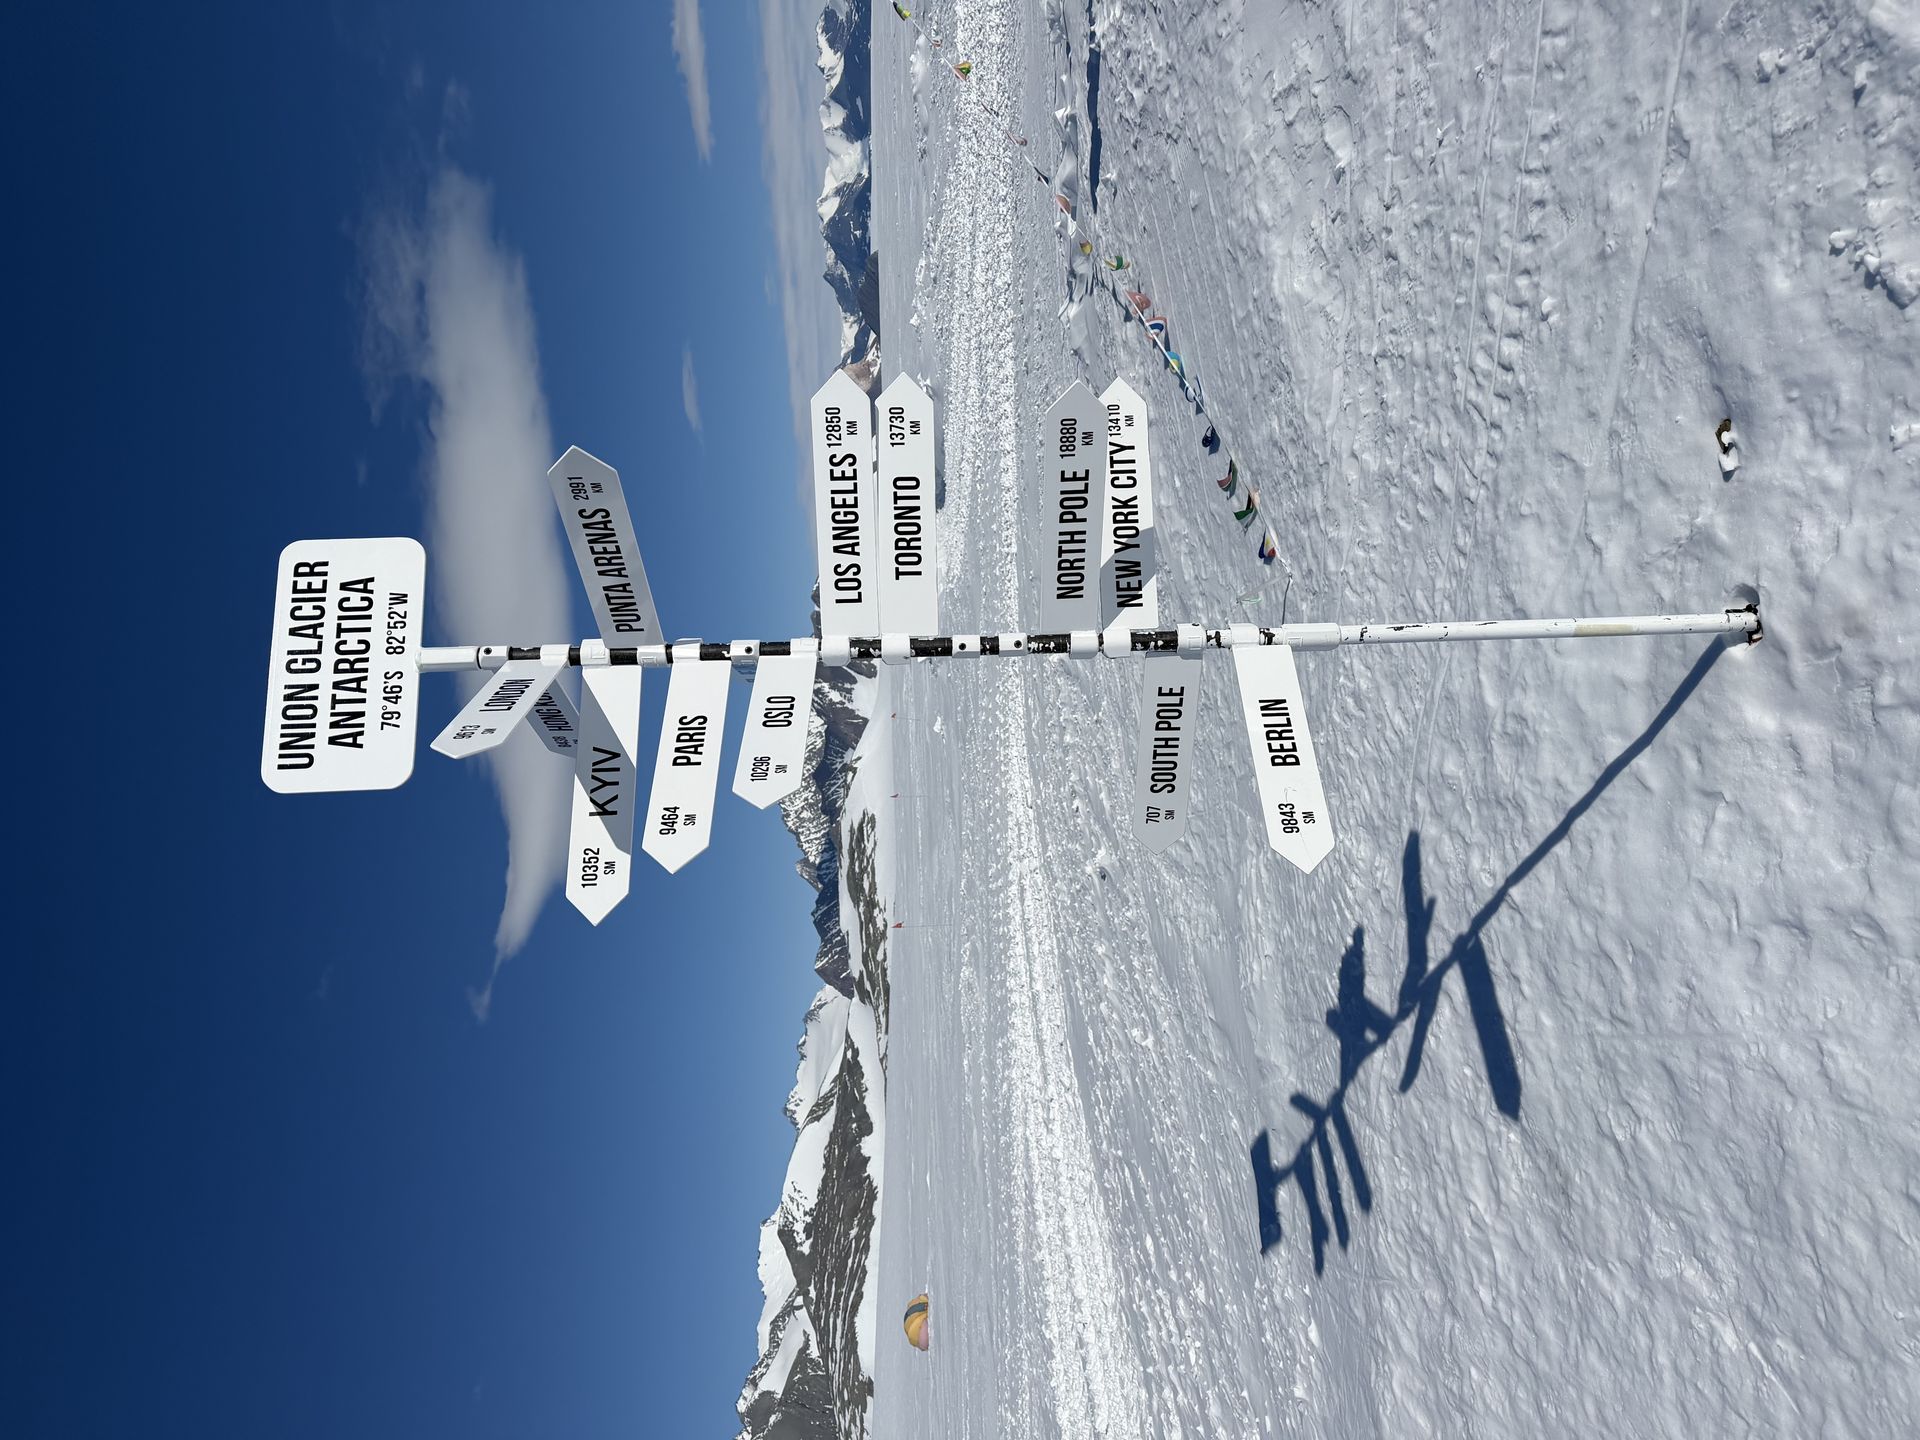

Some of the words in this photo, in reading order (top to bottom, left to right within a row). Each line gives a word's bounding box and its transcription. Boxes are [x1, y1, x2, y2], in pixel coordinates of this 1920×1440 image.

[824, 406, 843, 449] 12850
[846, 420, 858, 436] KM
[888, 406, 906, 448] 13730
[909, 420, 921, 435] KM
[1059, 418, 1078, 460] 18880
[1081, 431, 1094, 446] KM
[1106, 404, 1122, 438] 13410
[1124, 415, 1135, 427] KM
[1108, 441, 1138, 489] CITY
[567, 476, 589, 501] 2991
[590, 482, 604, 494] KM
[828, 453, 861, 557] ANGELES
[1058, 468, 1090, 524] POLE
[577, 508, 629, 578] ARENAS
[892, 476, 923, 581] TORONTO
[1111, 494, 1141, 555] YORK
[833, 563, 863, 604] LOS
[1056, 530, 1087, 600] NORTH
[1114, 559, 1144, 609] NEW
[285, 560, 330, 675] GLACIER
[602, 582, 645, 633] PUNTA
[327, 576, 375, 749] ANTARCTICA
[479, 678, 535, 712] LONDON
[534, 689, 557, 706] KO
[761, 695, 796, 728] OSLO
[1154, 686, 1185, 732] POLE
[276, 683, 320, 770] UNION
[453, 725, 481, 740] 9613
[535, 708, 574, 731] HONG
[1258, 698, 1301, 767] BERLIN
[671, 715, 708, 767] PARIS
[588, 746, 622, 817] KYIV
[749, 756, 771, 782] 10296
[774, 764, 788, 774] SM
[1149, 737, 1180, 794] SOUTH
[658, 806, 680, 836] 9464
[683, 814, 697, 826] SM
[1145, 805, 1161, 825] 707
[1164, 809, 1175, 821] SM
[1277, 803, 1300, 834] 9843
[1301, 811, 1316, 824] SM
[581, 847, 600, 889] 10352
[603, 861, 616, 875] SM
